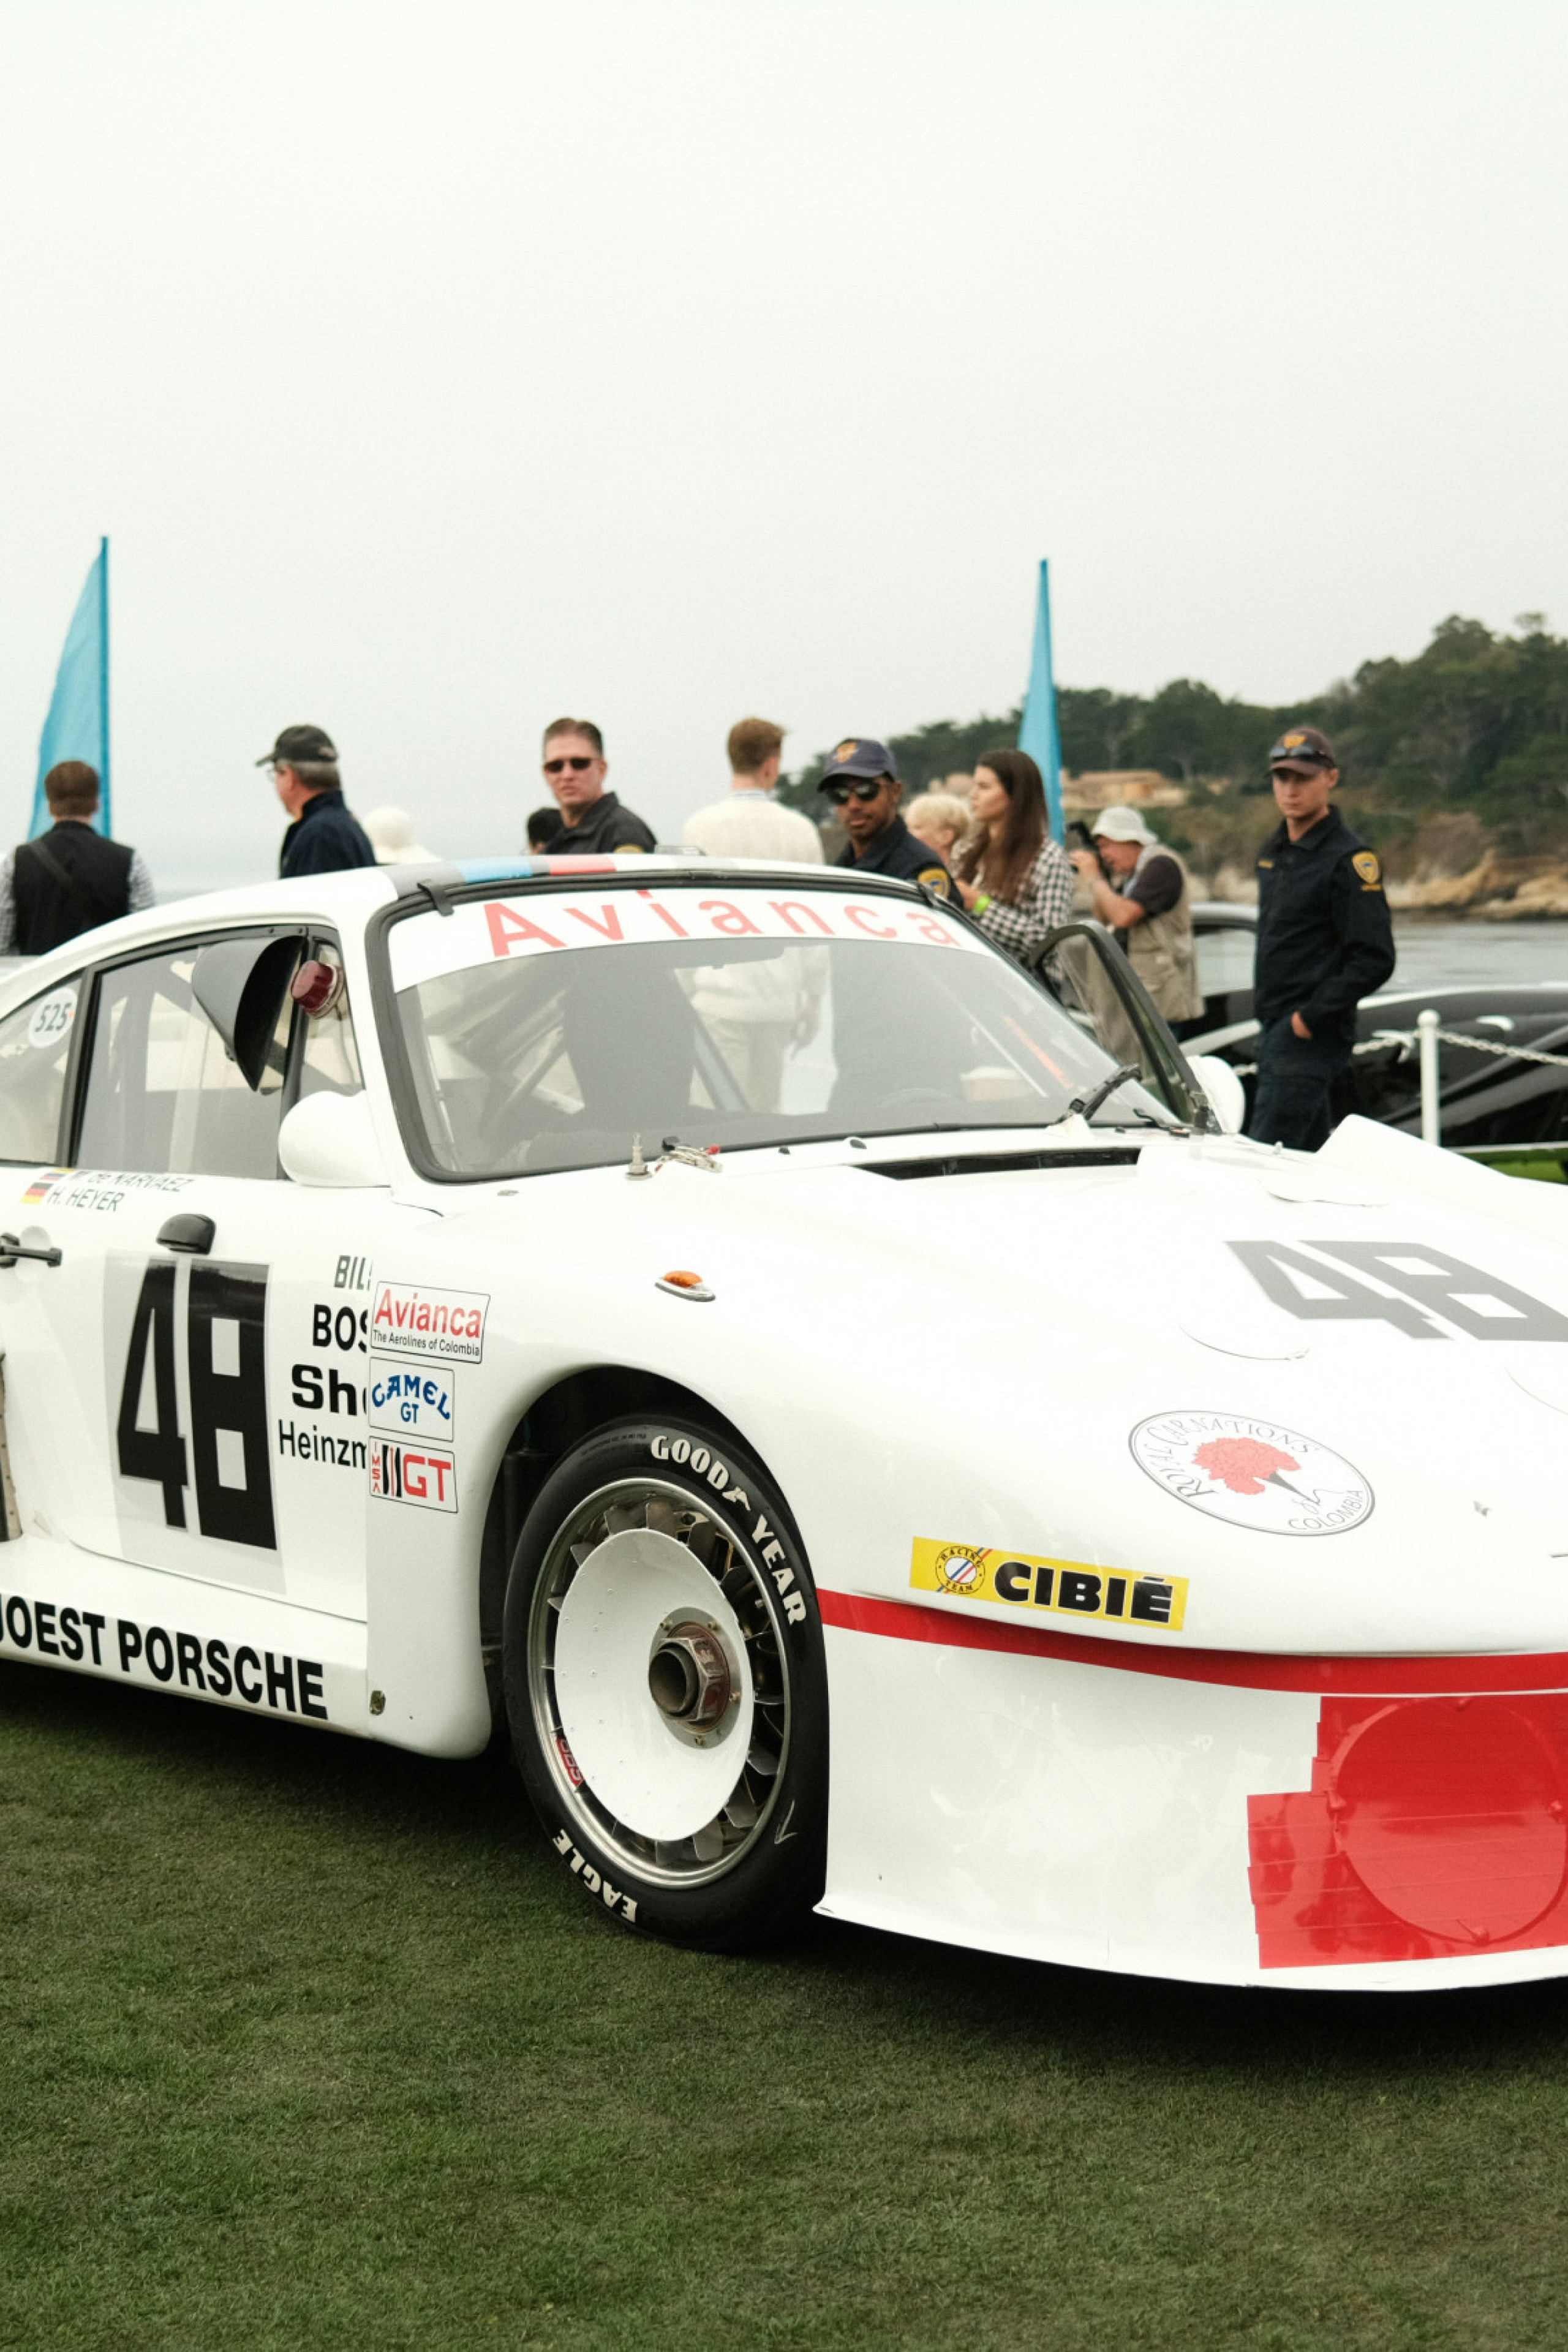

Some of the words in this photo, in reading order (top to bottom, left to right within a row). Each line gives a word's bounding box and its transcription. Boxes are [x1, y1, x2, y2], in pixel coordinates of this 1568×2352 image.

[483, 889, 960, 957] Avianca
[34, 1003, 72, 1032] 525
[66, 1188, 125, 1212] HEYER
[334, 1254, 373, 1291] BIL
[1223, 1240, 1568, 1342] 48
[374, 1289, 481, 1338] Avianca
[373, 1329, 387, 1343] The
[429, 1338, 437, 1351] of
[439, 1339, 480, 1356] Colombia
[117, 1256, 277, 1550] 48
[292, 1363, 366, 1416] Sh
[372, 1374, 451, 1420] CAMEL
[401, 1402, 420, 1423] GT
[403, 1453, 451, 1502] GT
[1288, 1490, 1363, 1530] COLOMBIA
[941, 1547, 982, 1568] RACING
[993, 1560, 1173, 1624] CIBIÉ
[0, 1594, 105, 1667] OEST
[117, 1619, 328, 1720] PORSCHE
[552, 1829, 638, 1923] EAGLE
